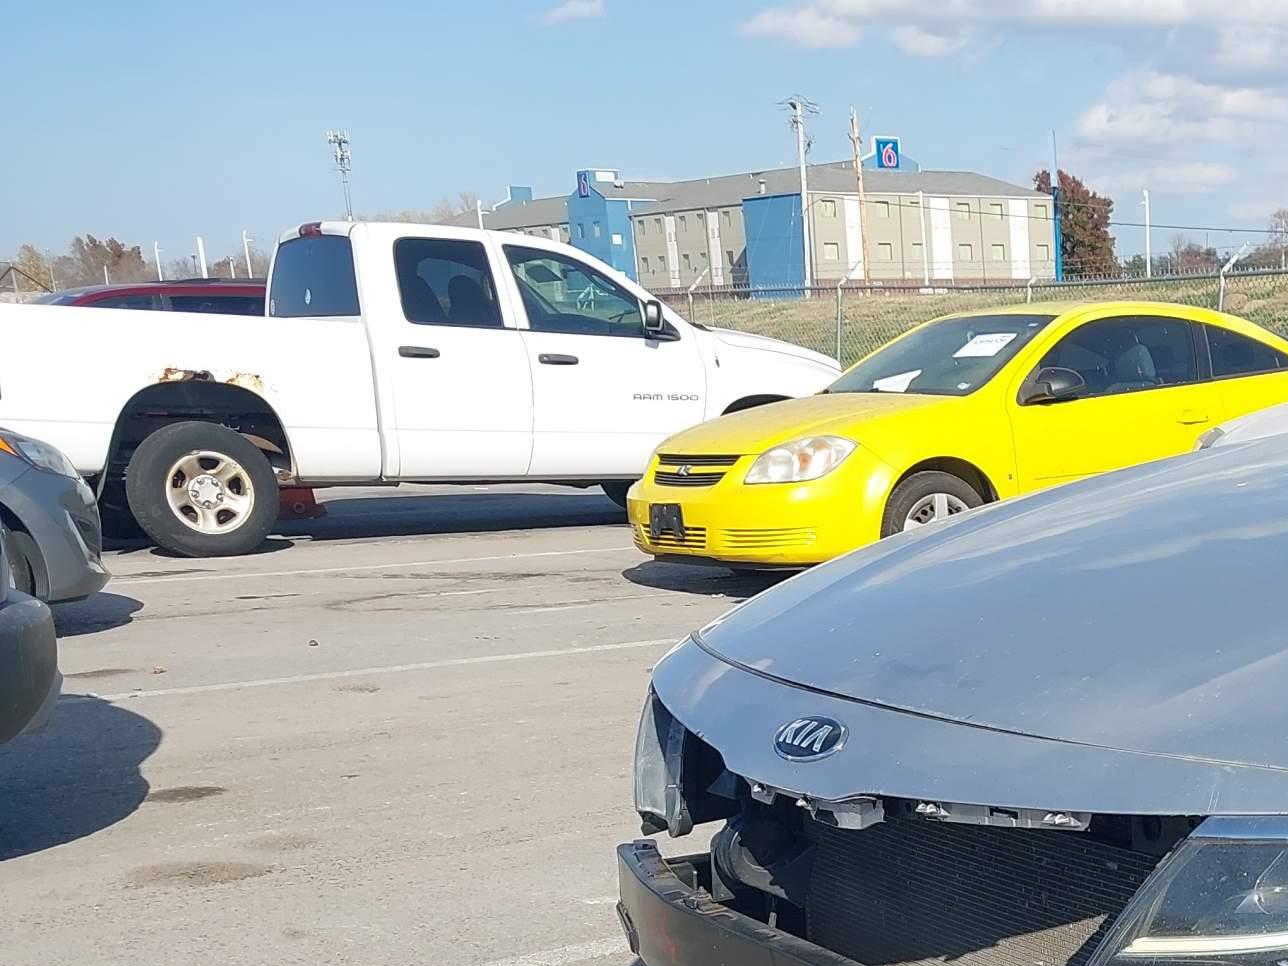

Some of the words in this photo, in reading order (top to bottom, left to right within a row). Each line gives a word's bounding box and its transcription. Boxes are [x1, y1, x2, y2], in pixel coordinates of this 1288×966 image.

[882, 142, 897, 167] 6
[633, 393, 663, 401] RAM
[778, 719, 833, 752] KIA
